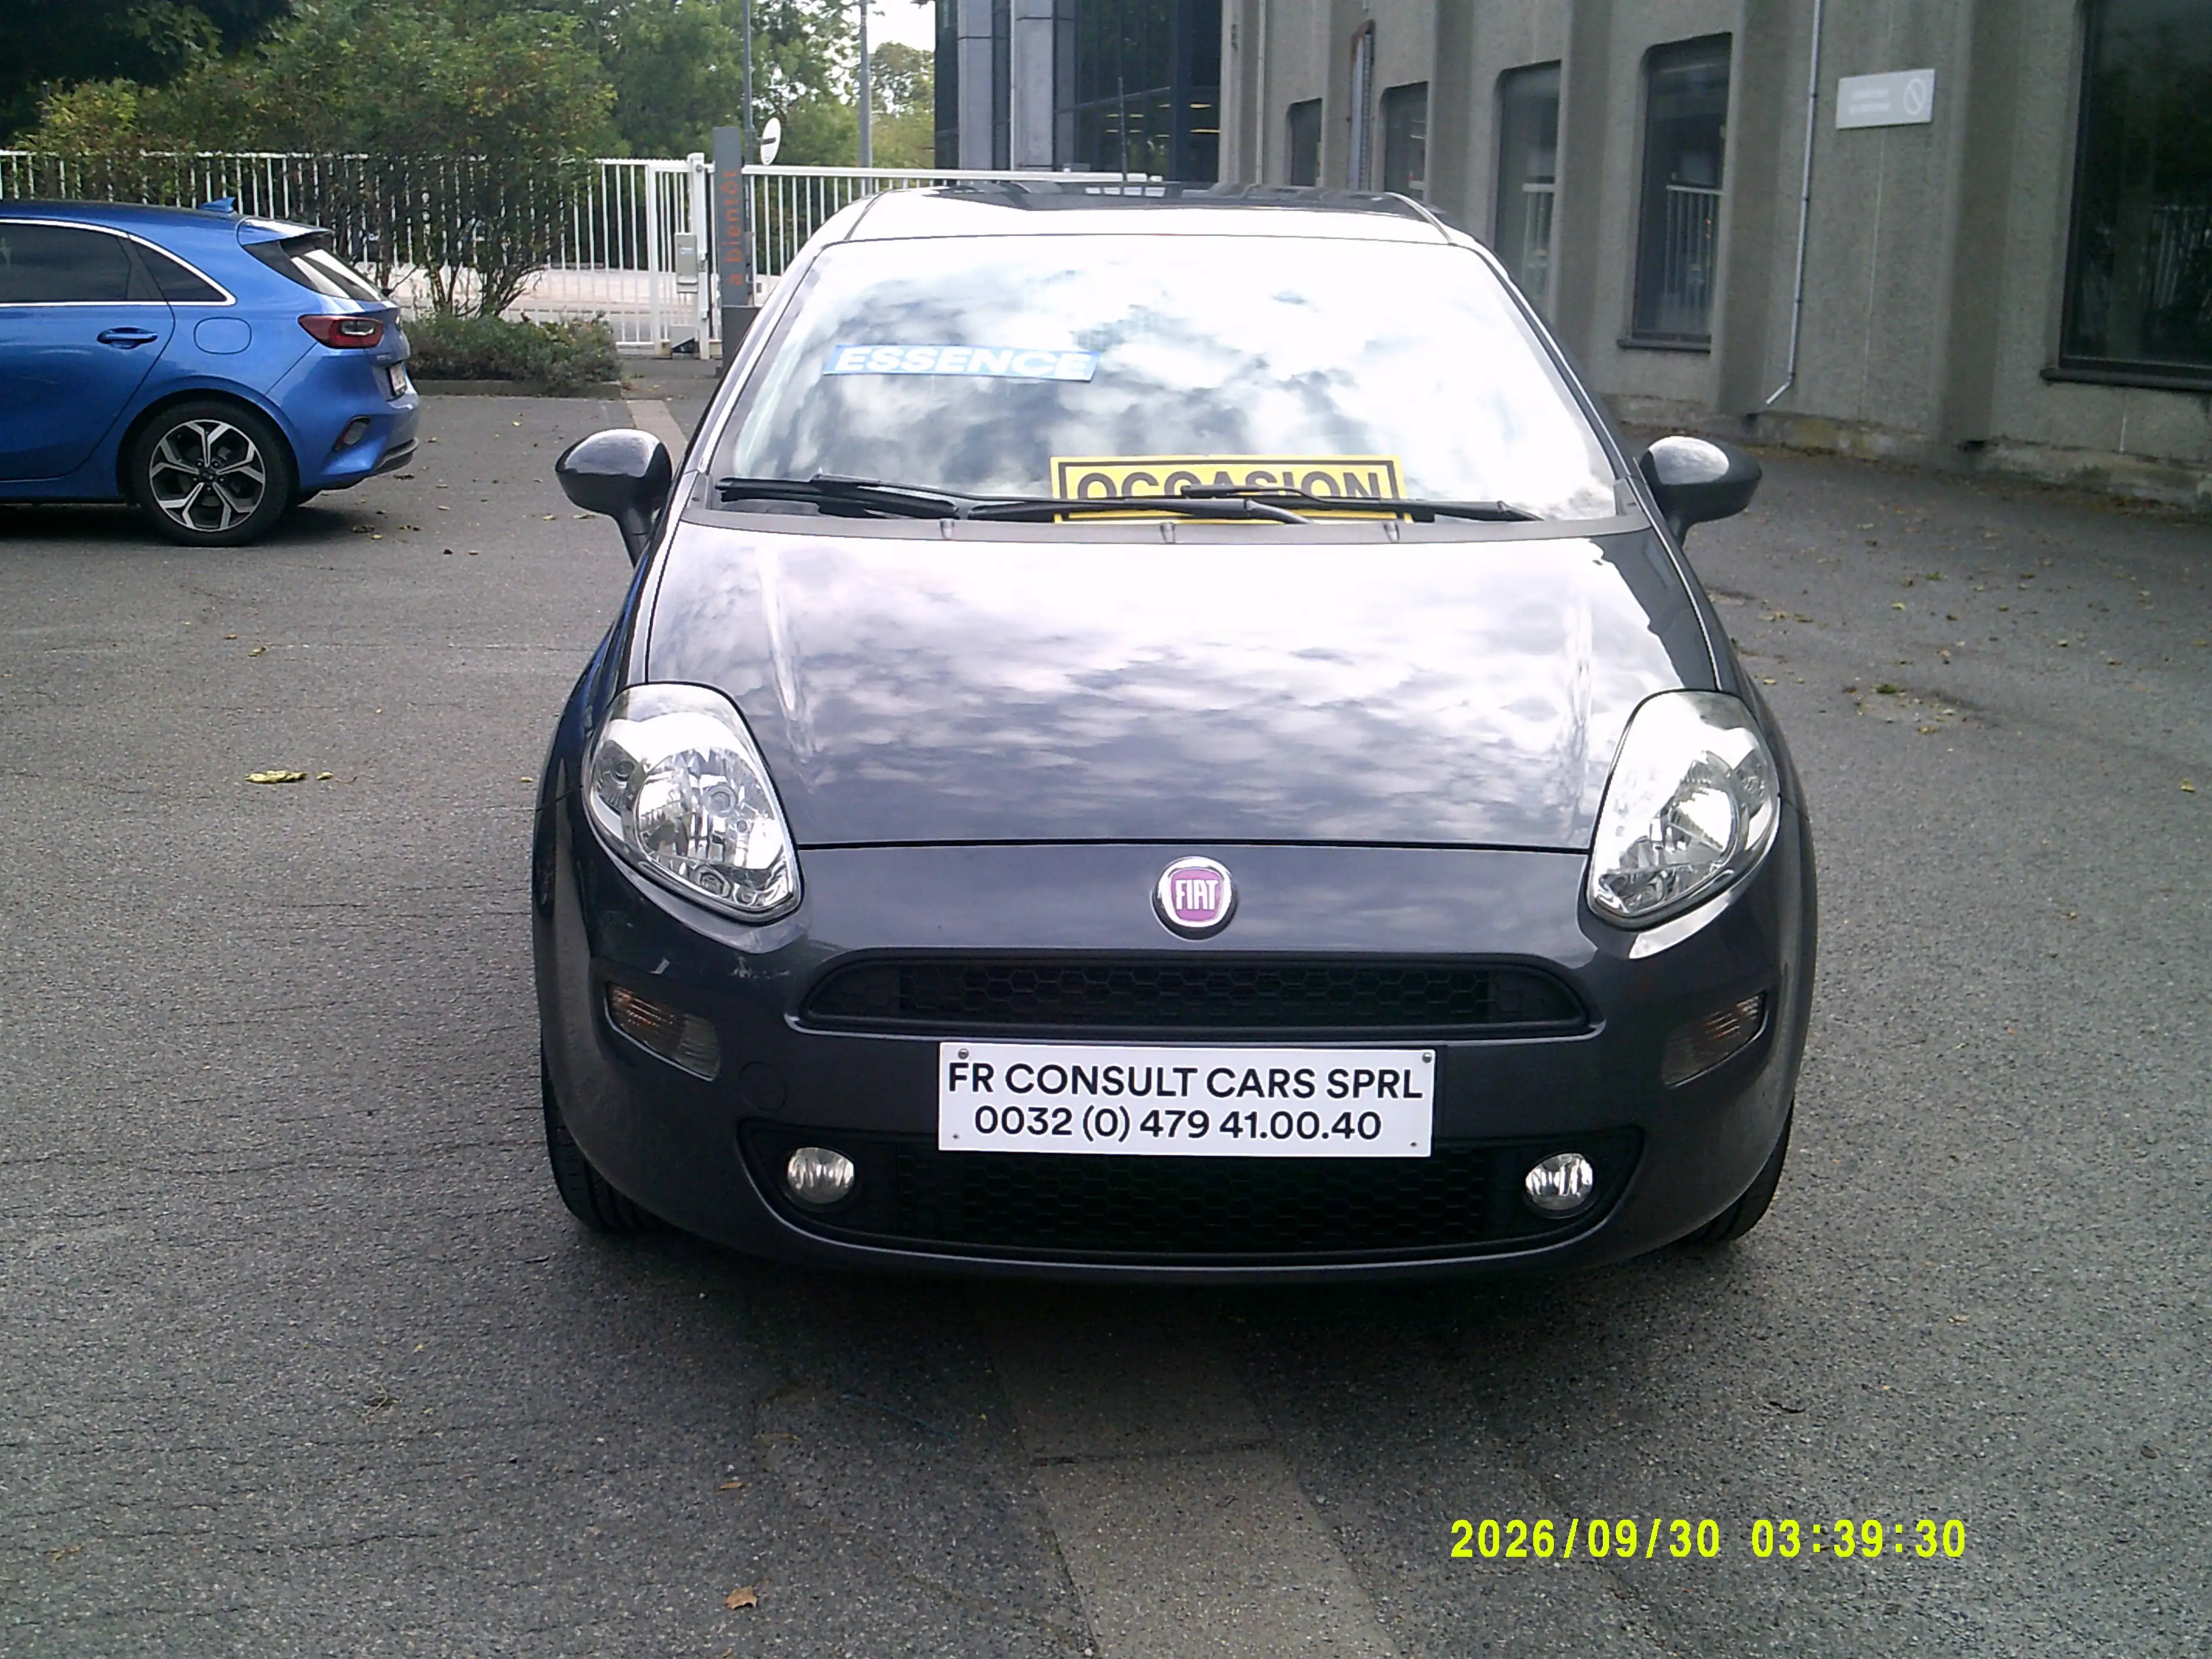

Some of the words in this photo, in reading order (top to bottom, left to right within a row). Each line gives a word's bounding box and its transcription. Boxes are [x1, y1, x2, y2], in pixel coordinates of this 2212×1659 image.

[721, 171, 742, 263] bientôt
[834, 346, 1090, 379] ESSENCE
[1175, 879, 1219, 910] FIAT
[949, 1062, 995, 1093] FR
[1005, 1063, 1198, 1097] CONSULT
[1206, 1067, 1316, 1099] CARS
[1326, 1068, 1423, 1099] SPRL
[975, 1105, 1073, 1136] 0032
[1139, 1109, 1210, 1139] 479
[1219, 1111, 1382, 1141] 41.00.40
